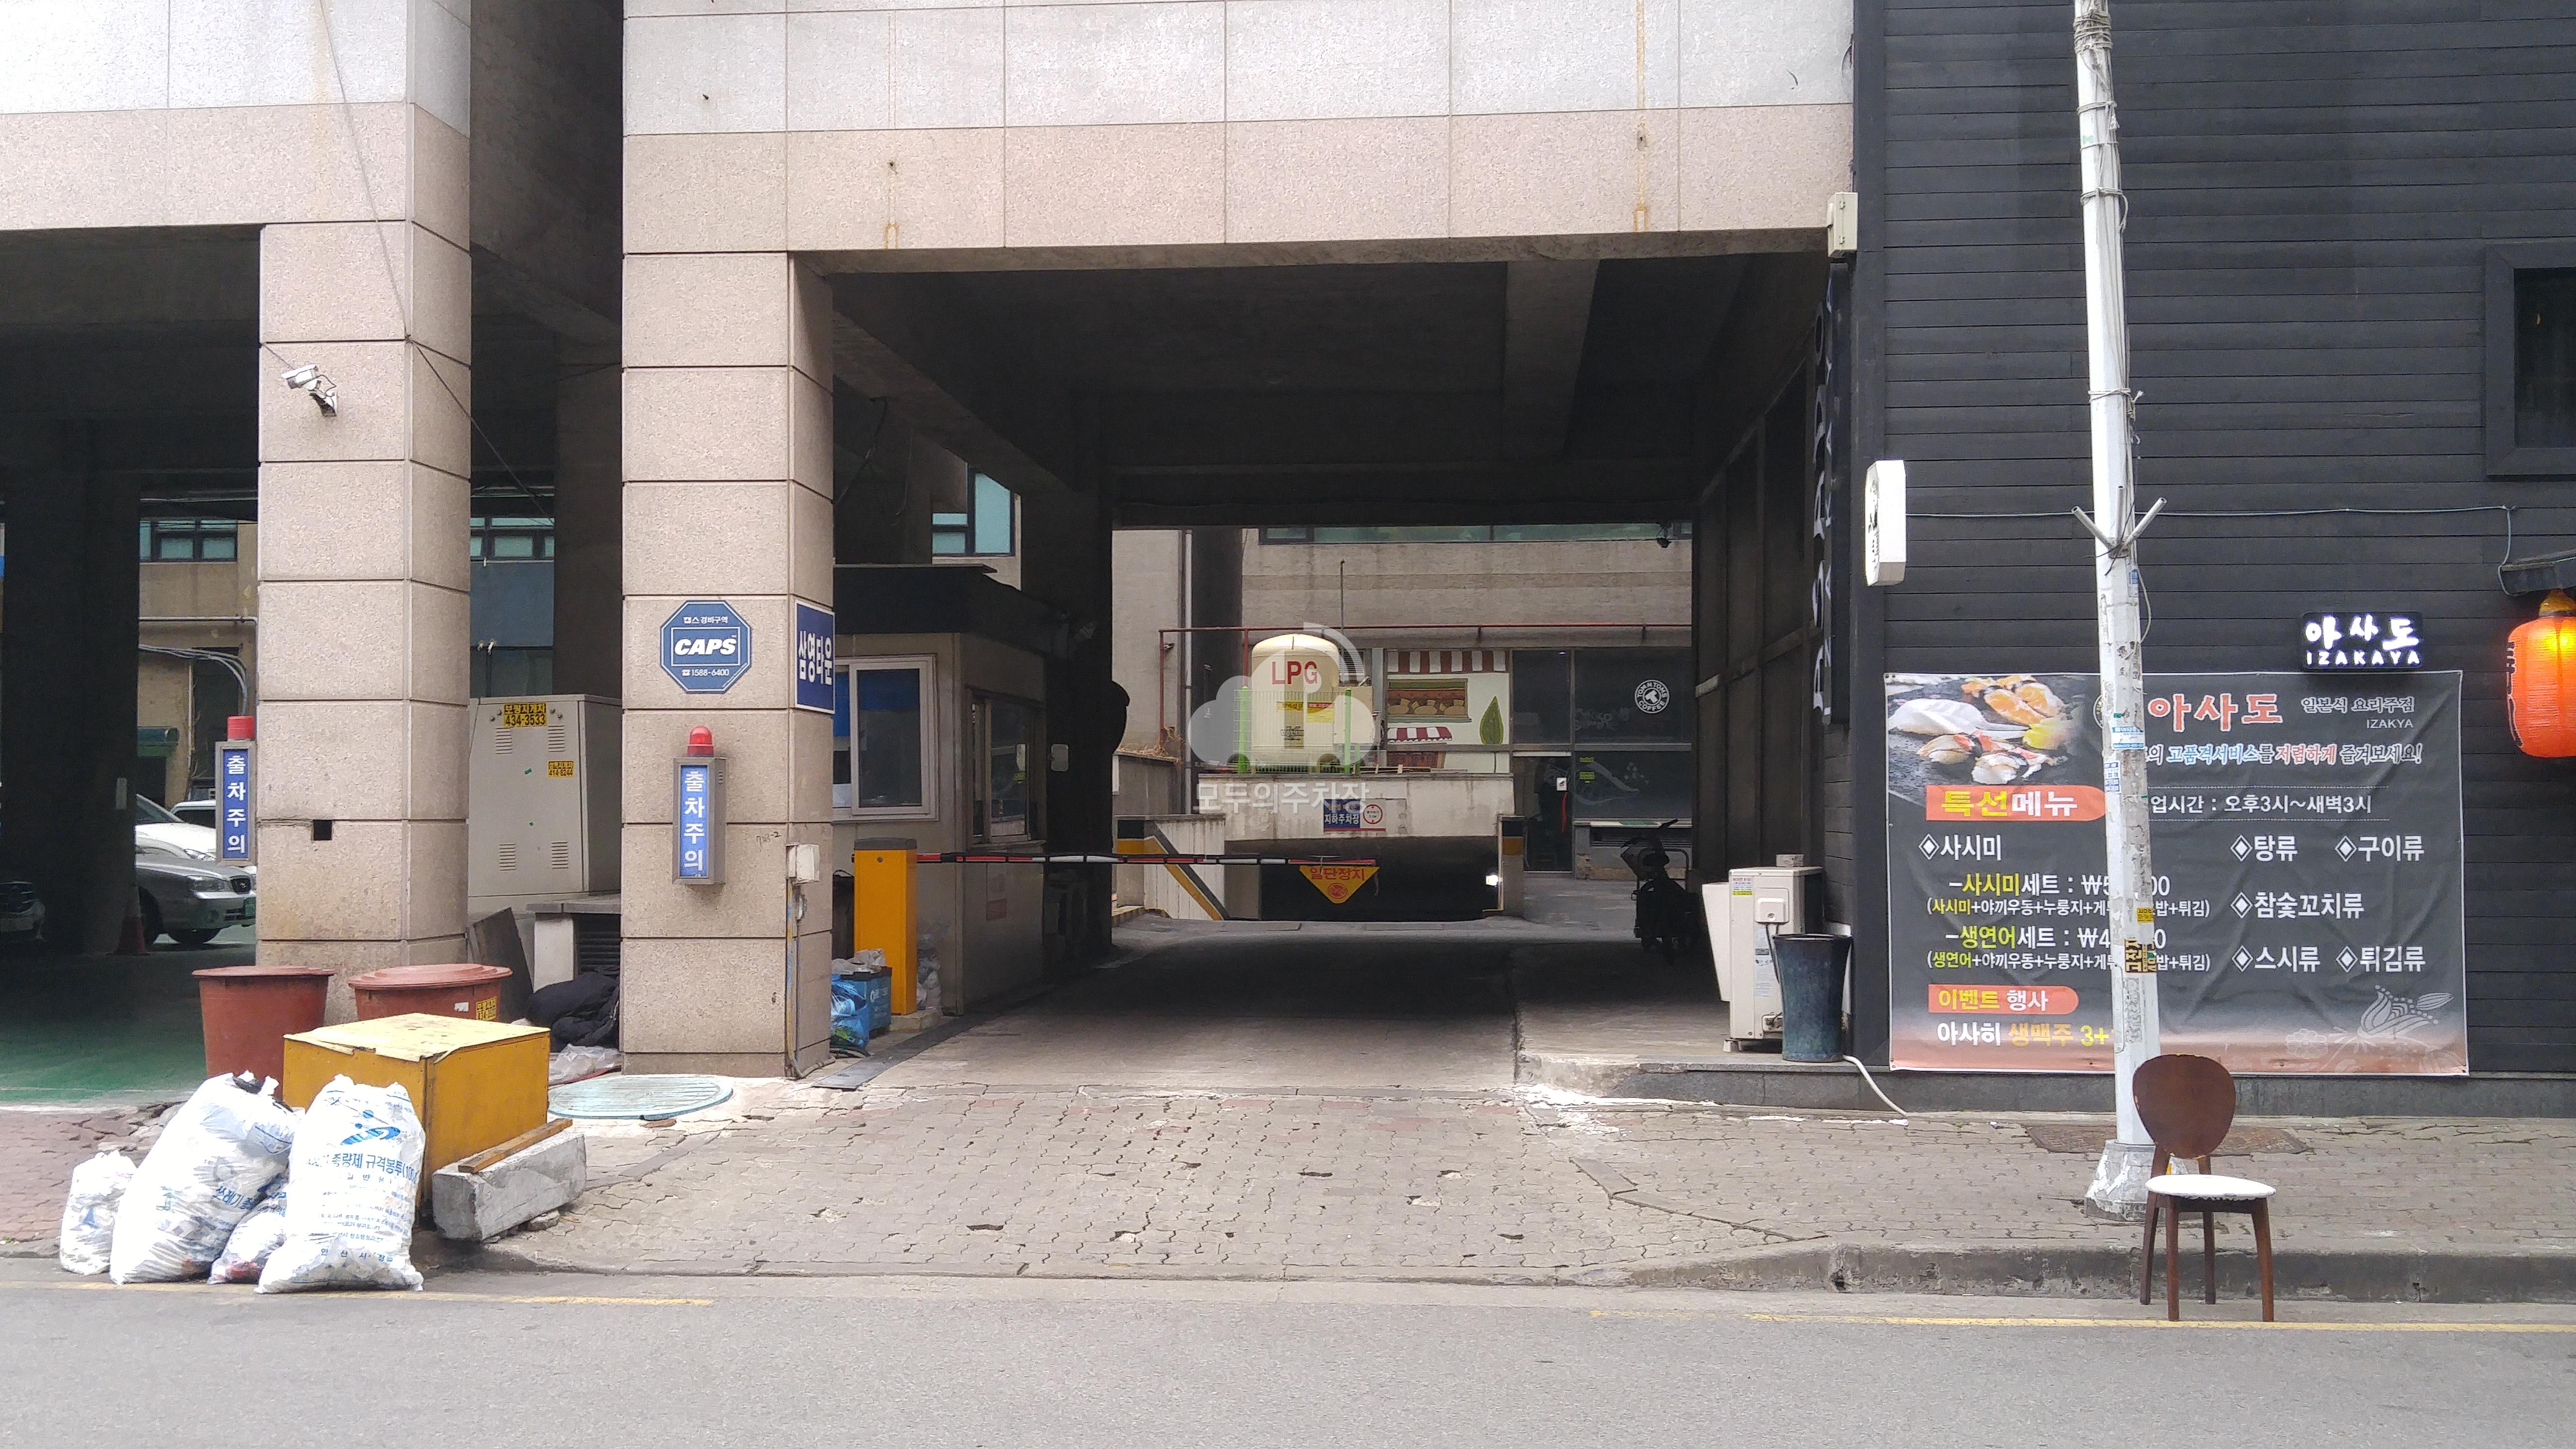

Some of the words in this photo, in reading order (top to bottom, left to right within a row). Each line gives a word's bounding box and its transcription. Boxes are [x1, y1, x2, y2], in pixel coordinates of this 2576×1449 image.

[2305, 614, 2420, 650] 아사도
[675, 638, 737, 655] CAPS
[798, 630, 833, 685] 삼영타운
[2306, 650, 2420, 666] IZAKAYA
[1272, 660, 1318, 685] LPG
[2147, 692, 2284, 733] 아사도
[2301, 696, 2348, 713] 일본식
[2351, 696, 2415, 713] 요리주점
[505, 714, 546, 726] 434-3533
[2367, 719, 2414, 729] IZAKYA
[2166, 743, 2274, 766] 고품격서비스를
[2275, 742, 2337, 766] 저렴하게
[2340, 742, 2423, 766] 즐겨보세요!
[226, 755, 246, 855] 출차주의
[1941, 790, 2078, 817] 특선메뉴
[2151, 795, 2205, 814] 업시간
[683, 770, 706, 871] 출차주의
[1324, 813, 1359, 824] 지하주차장
[1940, 834, 2002, 861] 사시미
[2254, 835, 2298, 862] 탕류
[2358, 835, 2425, 862] 구이류
[1310, 867, 1366, 882] 일단정지
[2254, 892, 2365, 919] 참숯꼬치류
[2254, 945, 2321, 973] 스시류
[2360, 945, 2426, 973] 튀김류
[1938, 989, 2000, 1010] 이벤트
[2007, 990, 2049, 1012] 행사
[1937, 1021, 2001, 1046] 아사히
[2009, 1022, 2074, 1047] 생맥주
